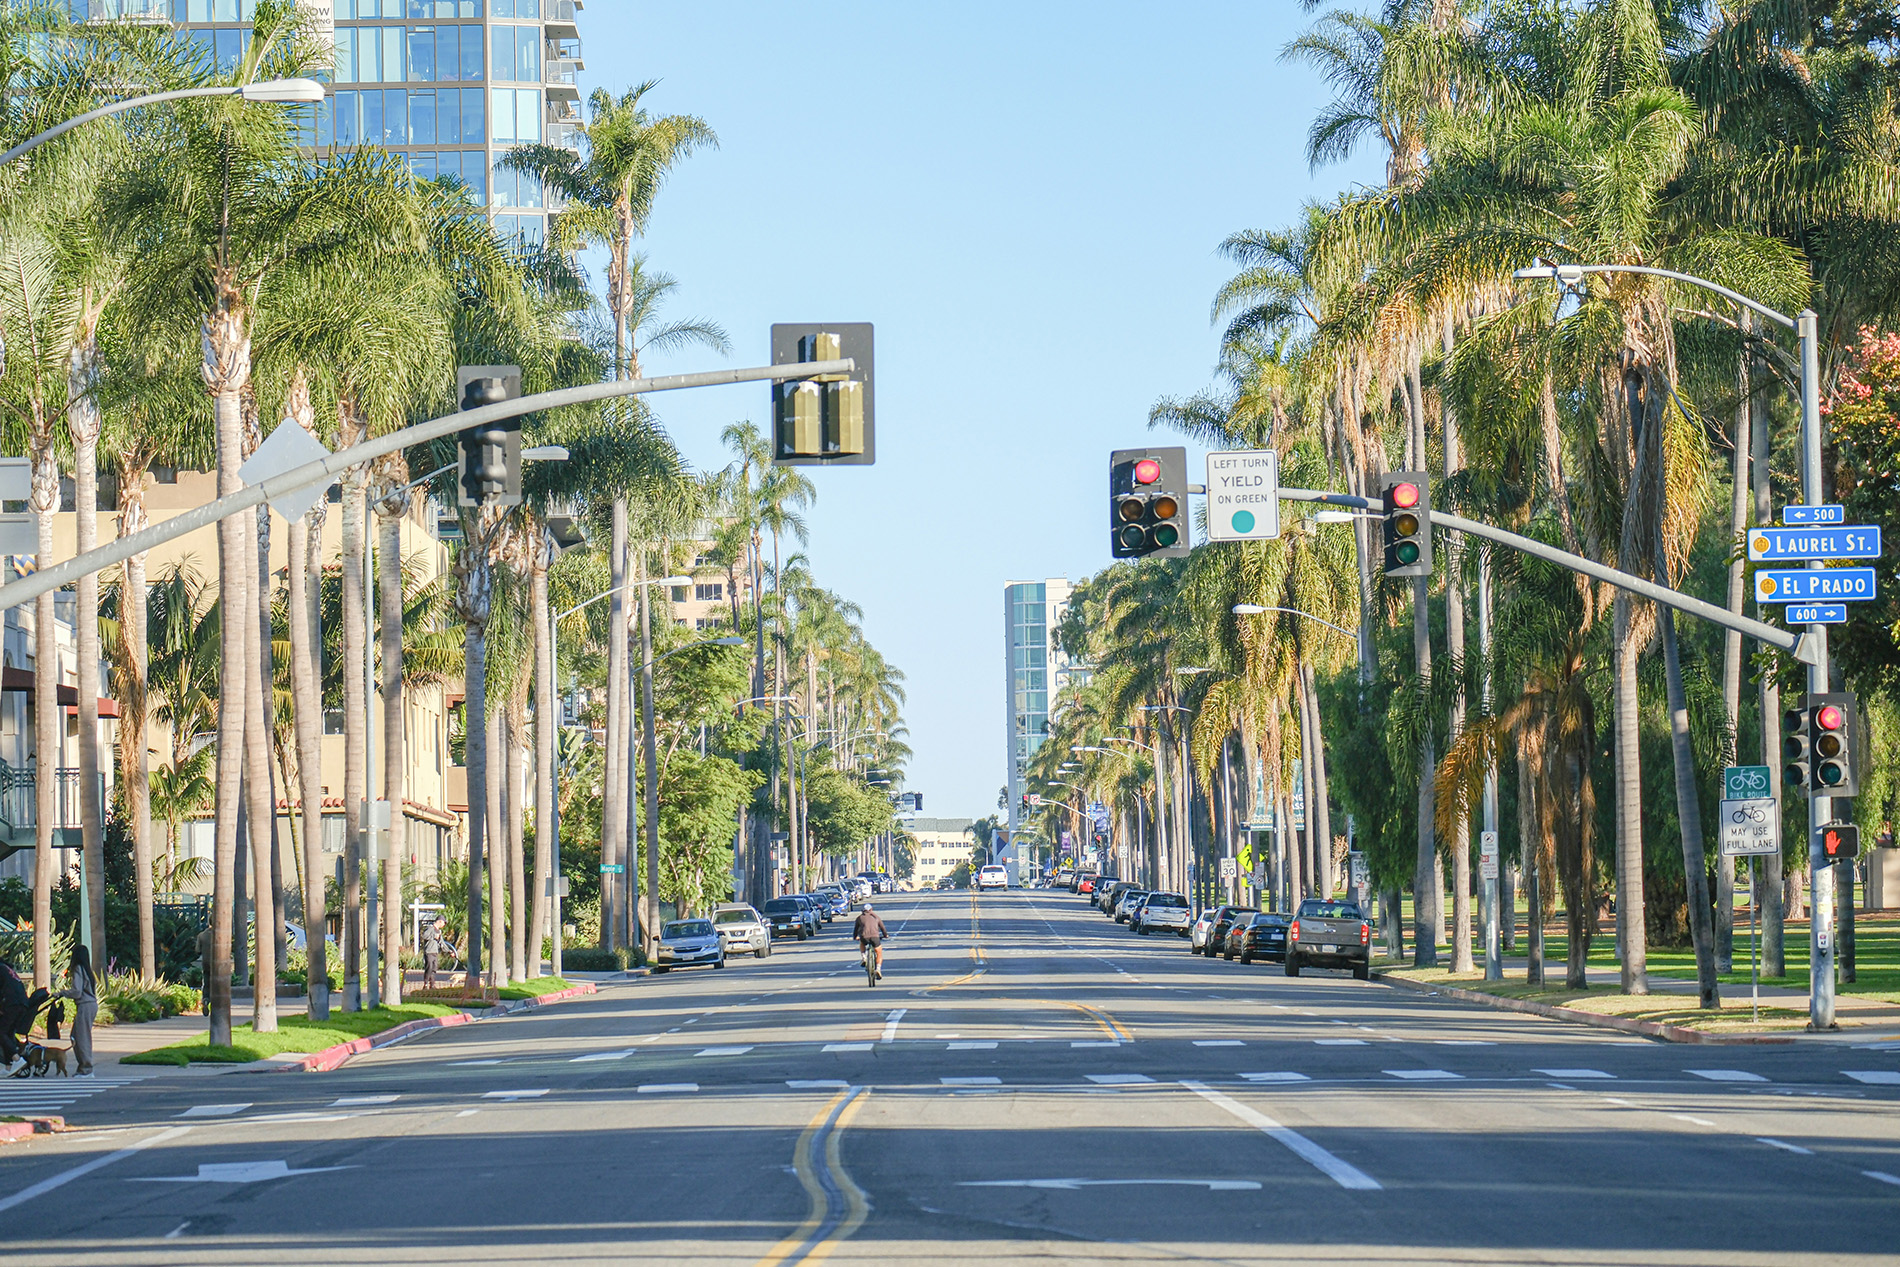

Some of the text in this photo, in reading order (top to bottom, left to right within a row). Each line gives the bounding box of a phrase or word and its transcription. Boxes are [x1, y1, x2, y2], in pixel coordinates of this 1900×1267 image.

[1214, 458, 1269, 469] LEFT TURN
[1220, 475, 1263, 487] YIELD
[1217, 494, 1268, 504] ON GREEN
[1813, 508, 1835, 520] 500
[1776, 533, 1872, 553] LAUREL ST.
[1782, 576, 1866, 595] EL PRADO
[1795, 608, 1817, 620] 600
[1731, 827, 1768, 836] MAY USE
[1726, 839, 1774, 849] FULL LANE
[1223, 867, 1236, 875] 30
